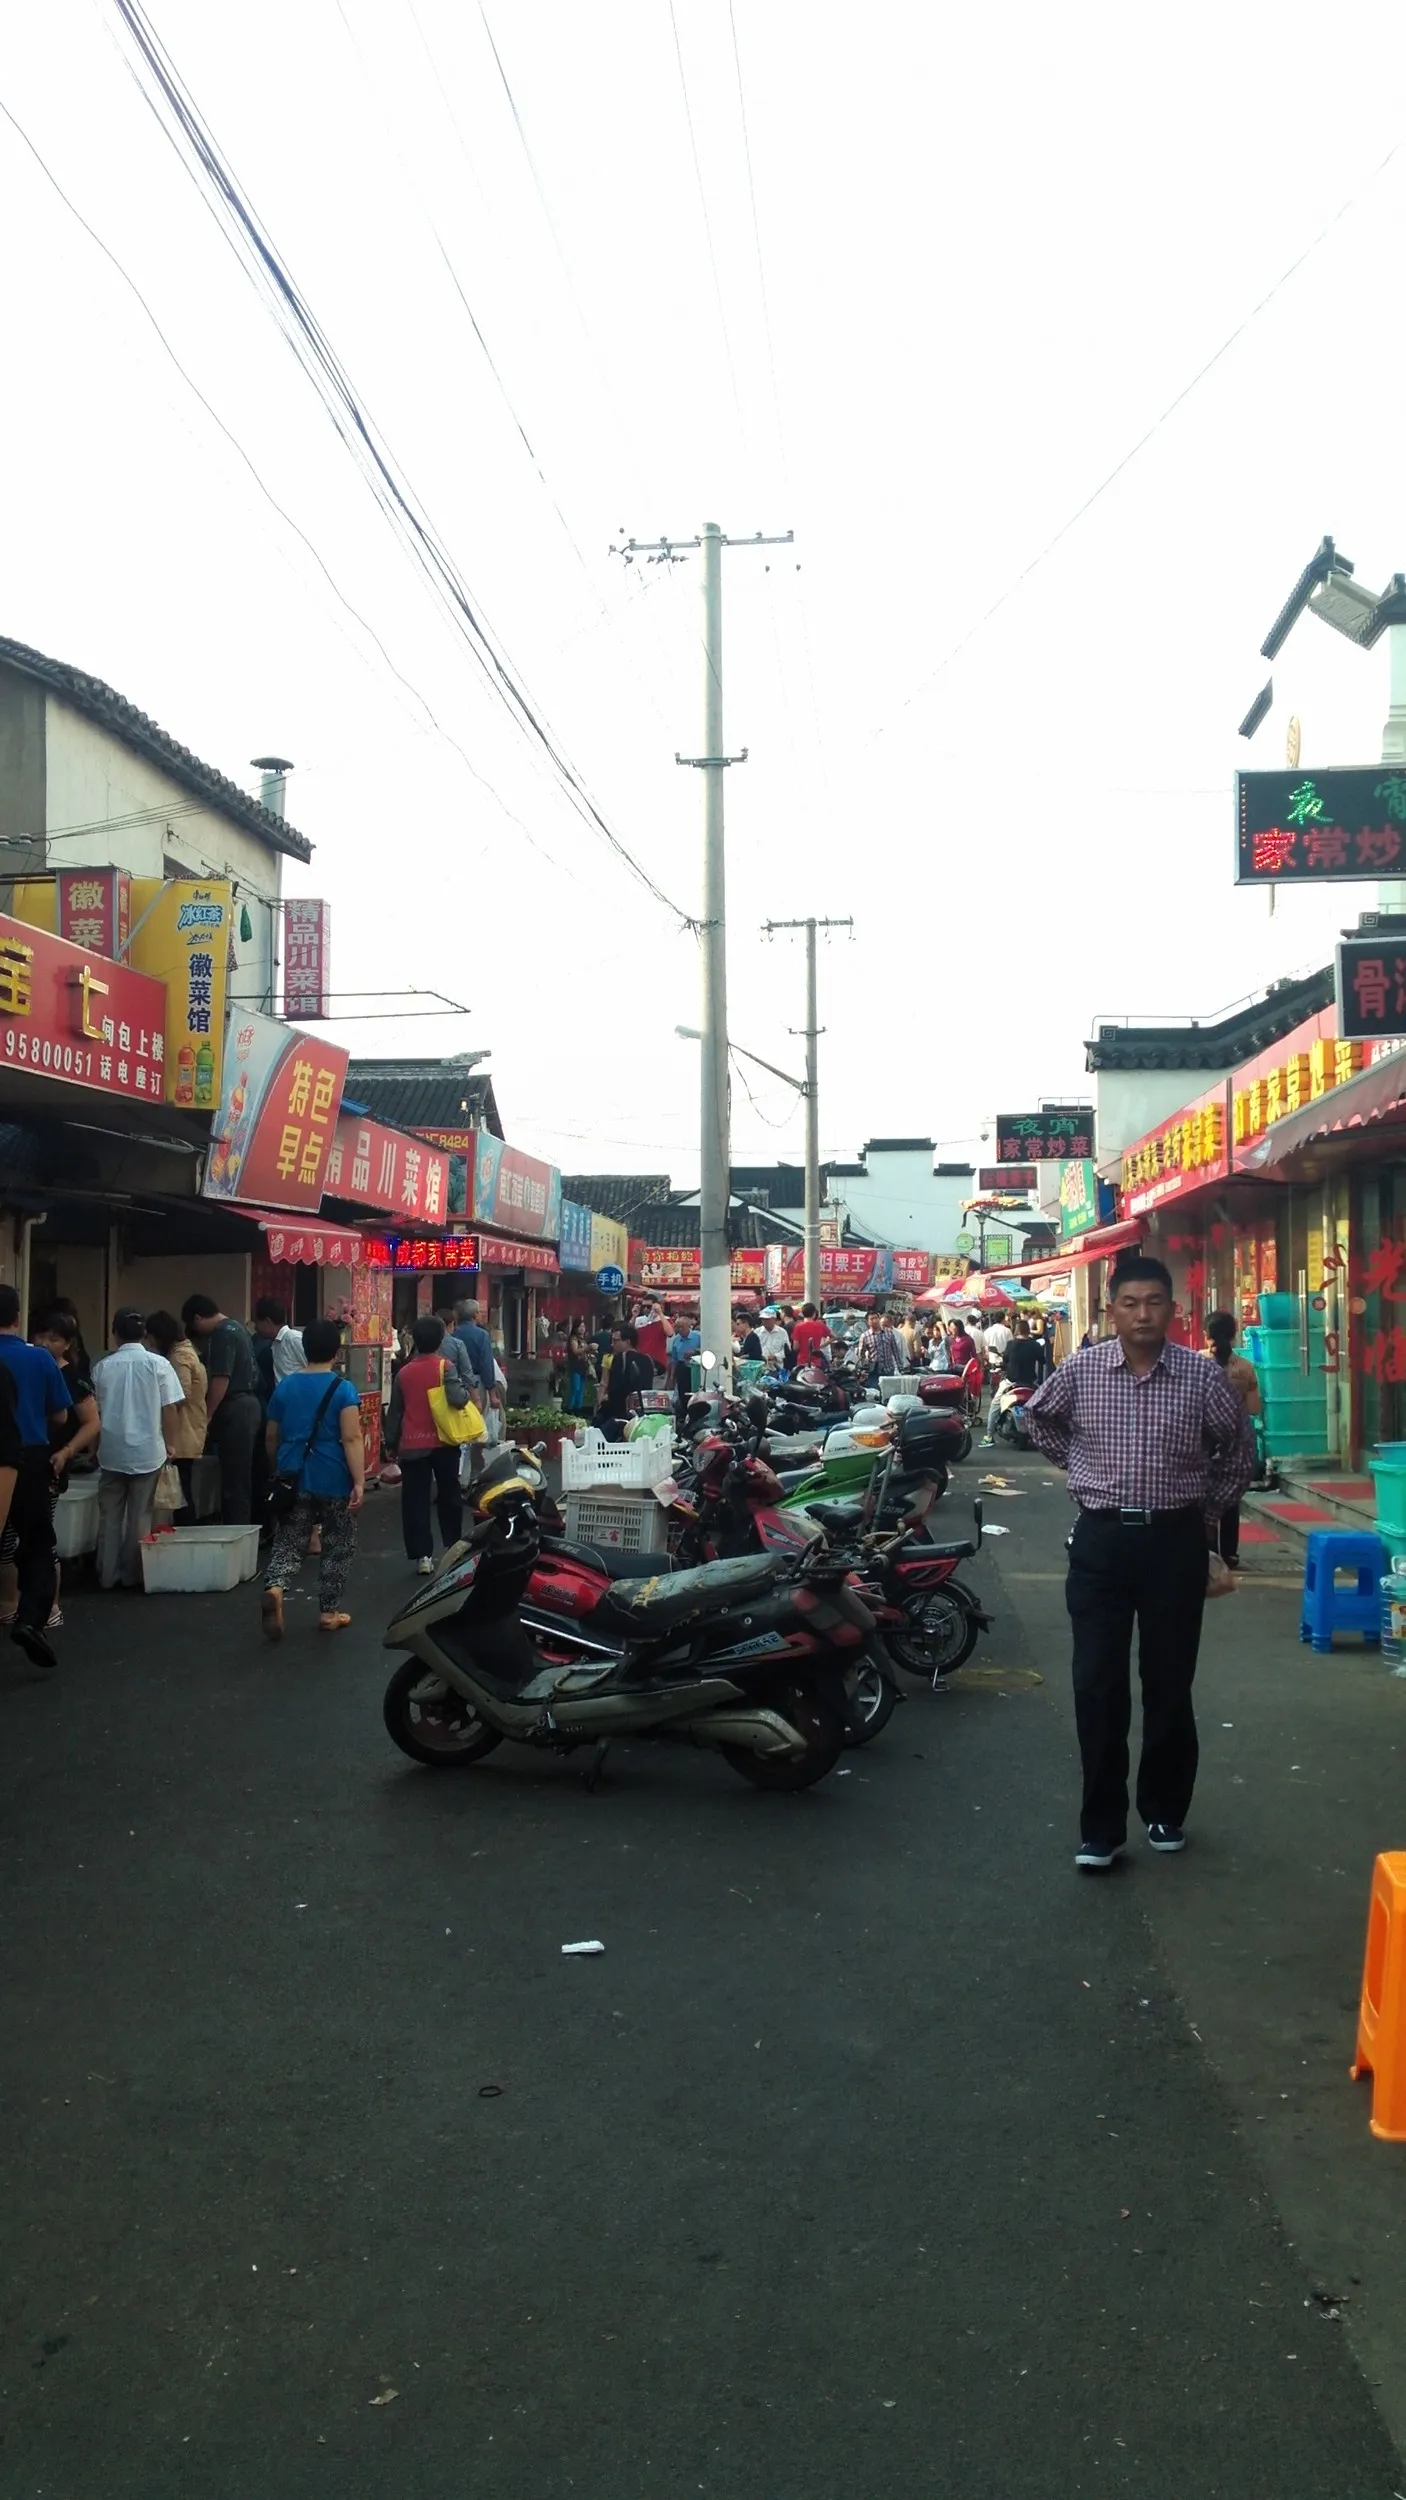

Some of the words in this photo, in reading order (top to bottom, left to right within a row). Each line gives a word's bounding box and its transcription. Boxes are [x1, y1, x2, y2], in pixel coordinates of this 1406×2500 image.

[1253, 824, 1401, 871] 家常炒
[178, 904, 223, 930] 冰红茶
[286, 899, 320, 1013] 精品川菜馆
[186, 953, 213, 1034] 徽菜馆
[1353, 959, 1406, 1018] 骨
[6, 1030, 92, 1077] 95800051
[288, 1059, 337, 1125] 特色
[1003, 1135, 1090, 1158] 家常炒菜
[1012, 1116, 1079, 1137] 夜宵
[275, 1124, 325, 1186] 早点
[597, 1272, 623, 1287] 手机
